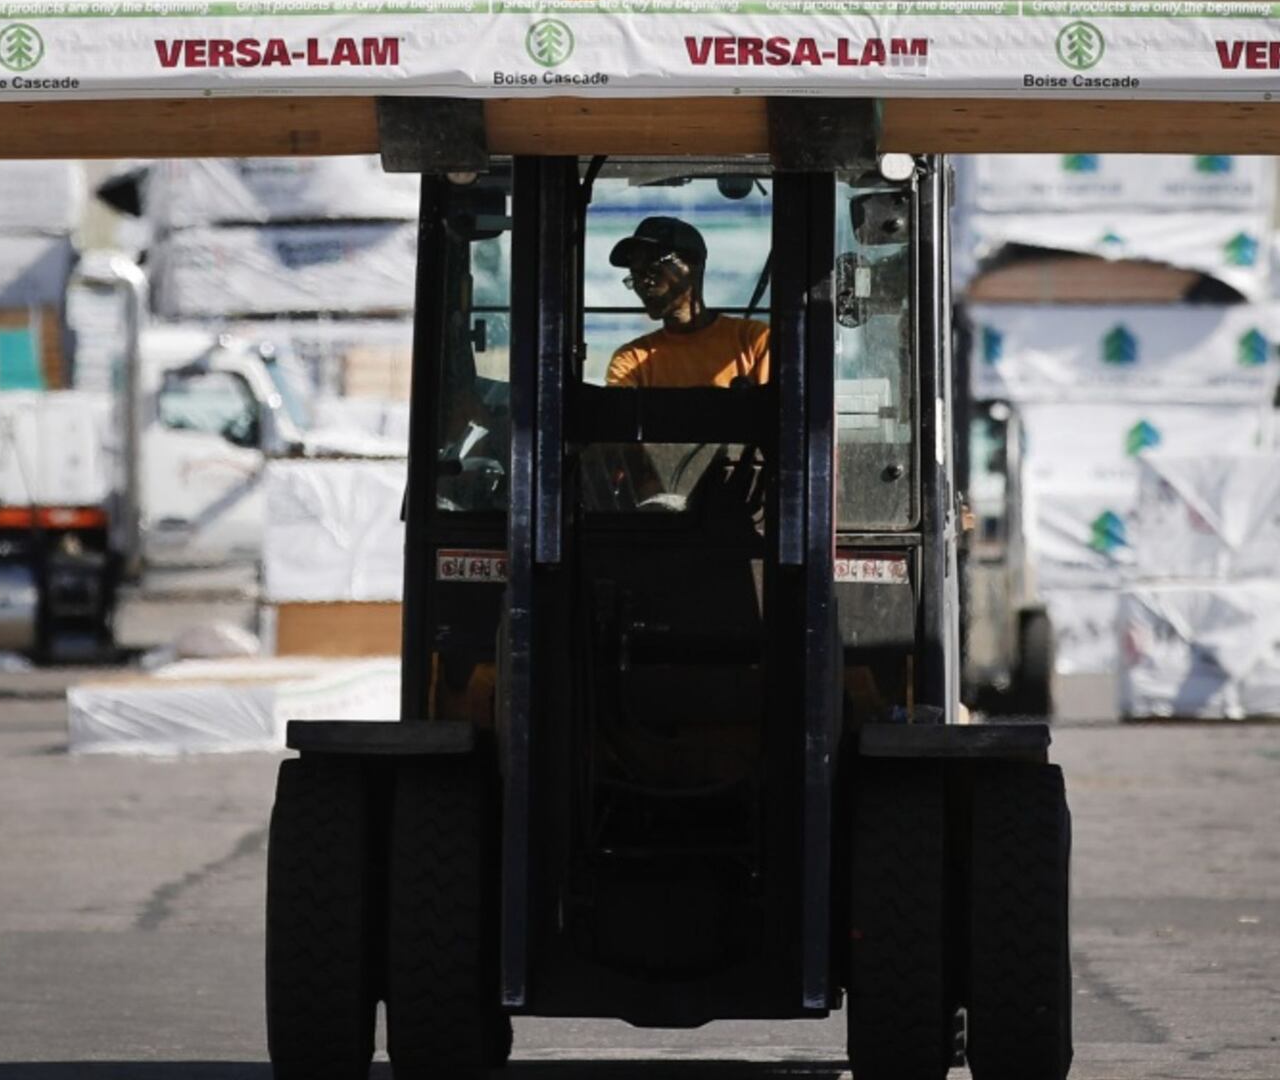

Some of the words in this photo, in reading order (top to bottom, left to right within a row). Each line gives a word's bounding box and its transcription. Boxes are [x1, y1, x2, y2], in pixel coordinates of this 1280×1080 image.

[1032, 1, 1066, 12] Great
[1068, 0, 1126, 15] products
[1130, 3, 1150, 12] are
[1154, 1, 1182, 16] only
[1185, 1, 1204, 13] the
[155, 37, 399, 68] VERSA-LAM
[685, 36, 928, 66] VERSA-LAM
[12, 76, 80, 89] Cascade
[493, 71, 537, 85] Boise
[543, 71, 609, 85] Cascade
[1023, 74, 1068, 87] Boise
[1072, 74, 1140, 88] Cascade
